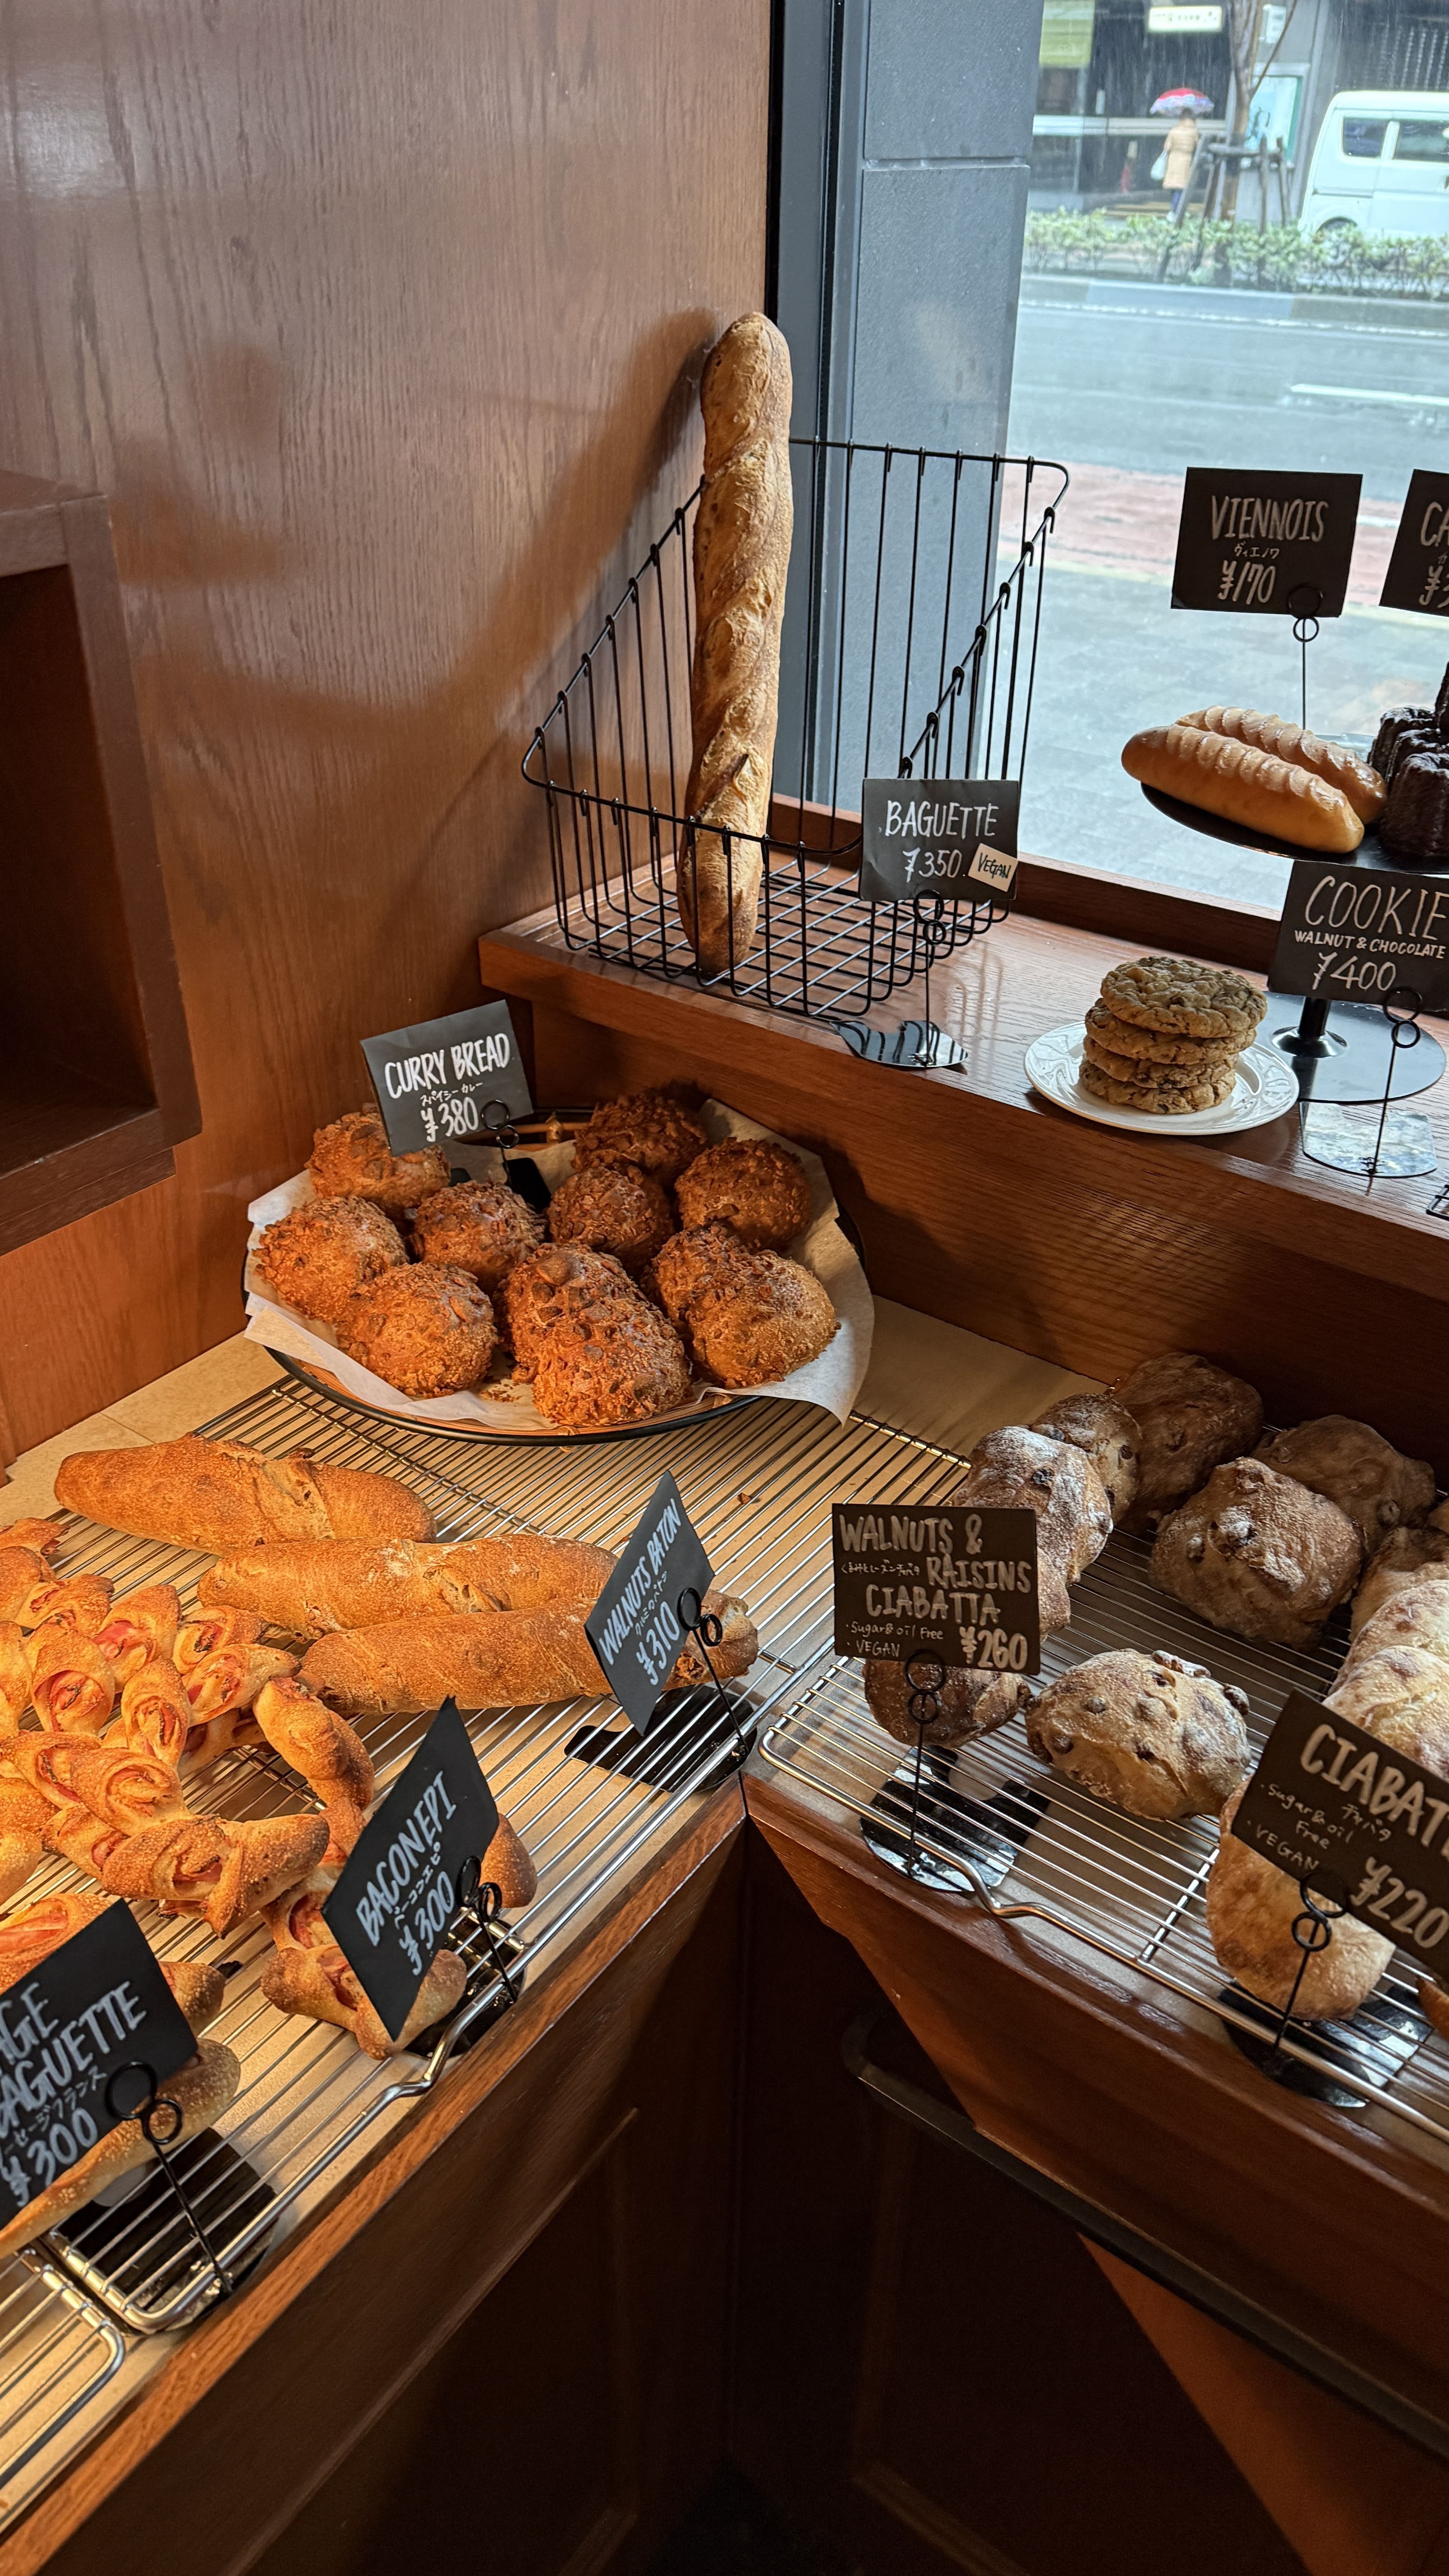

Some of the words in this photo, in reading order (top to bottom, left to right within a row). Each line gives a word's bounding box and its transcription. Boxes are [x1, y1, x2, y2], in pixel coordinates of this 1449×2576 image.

[1211, 496, 1329, 542] VIENNOIS
[1234, 541, 1280, 559] ヴィエノワ
[1218, 560, 1276, 604] ¥170
[885, 800, 999, 839] BAGUETTE
[978, 852, 1012, 879] VEGAN
[1304, 875, 1449, 940] COOKIE
[1294, 930, 1355, 948] WALNUT
[1356, 936, 1367, 949] &
[1369, 938, 1446, 959] CHOCOLATE
[384, 1049, 446, 1099] CURRY
[451, 1033, 510, 1080] BREAD
[421, 1097, 479, 1142] ¥380
[839, 1514, 953, 1554] WALNUTS
[965, 1513, 983, 1555] &
[599, 1556, 652, 1665] WALNUTS
[647, 1498, 681, 1575] BATON
[926, 1553, 1032, 1593] RAISINS
[865, 1583, 1001, 1626] CIABATTA
[636, 1601, 680, 1685] ¥310
[856, 1639, 900, 1657] VEGAN
[920, 1627, 944, 1639] Free
[959, 1626, 1028, 1670] ¥260
[1256, 1824, 1320, 1870] VEGAN
[1295, 1820, 1329, 1849] Free
[399, 1871, 456, 1976] ¥300
[1350, 1856, 1449, 1949] ¥220
[0, 1982, 59, 2065] GE
[0, 1981, 147, 2139] AGUETTE
[0, 2107, 98, 2207] ¥300
